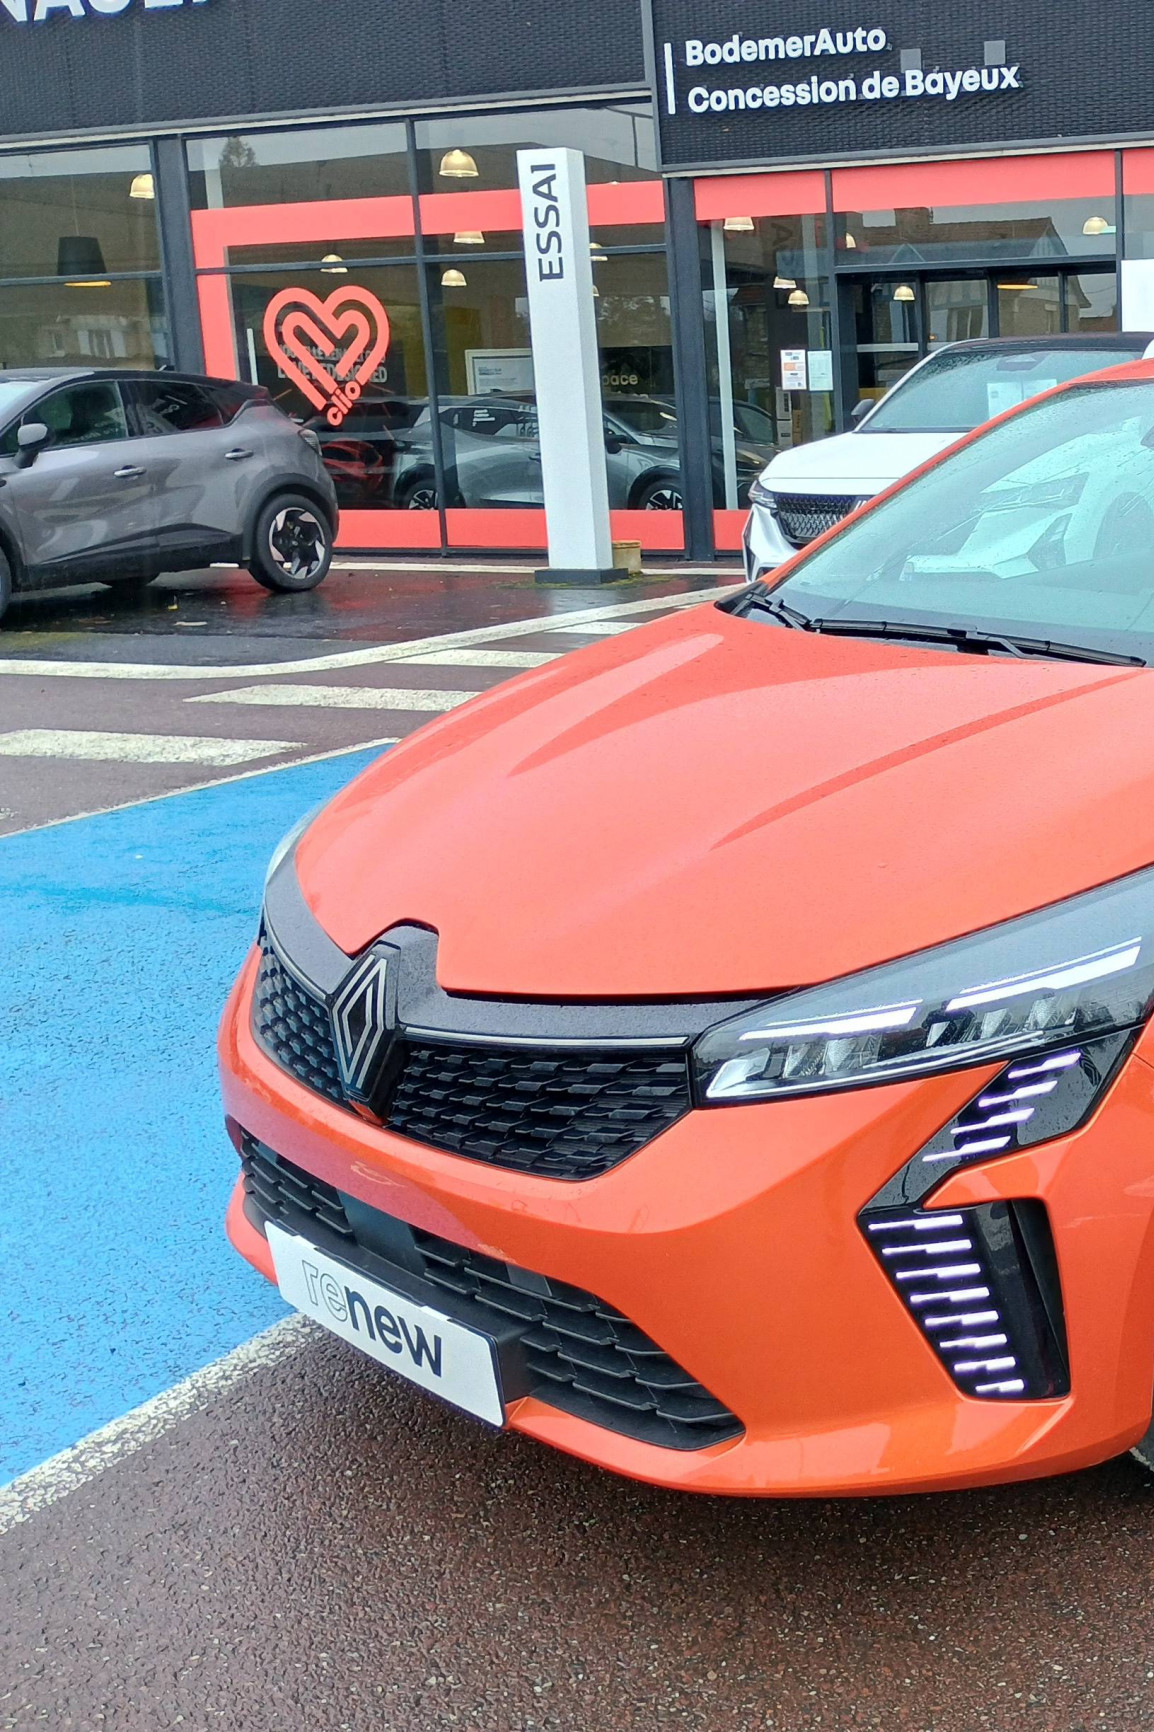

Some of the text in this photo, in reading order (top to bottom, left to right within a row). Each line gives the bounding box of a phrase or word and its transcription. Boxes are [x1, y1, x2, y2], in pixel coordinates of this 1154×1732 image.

[685, 27, 887, 66] BodemerAuto
[688, 65, 1020, 113] Concession de Bayeux
[530, 163, 564, 282] ESSAI
[326, 381, 361, 426] clio
[302, 1260, 442, 1378] renew
